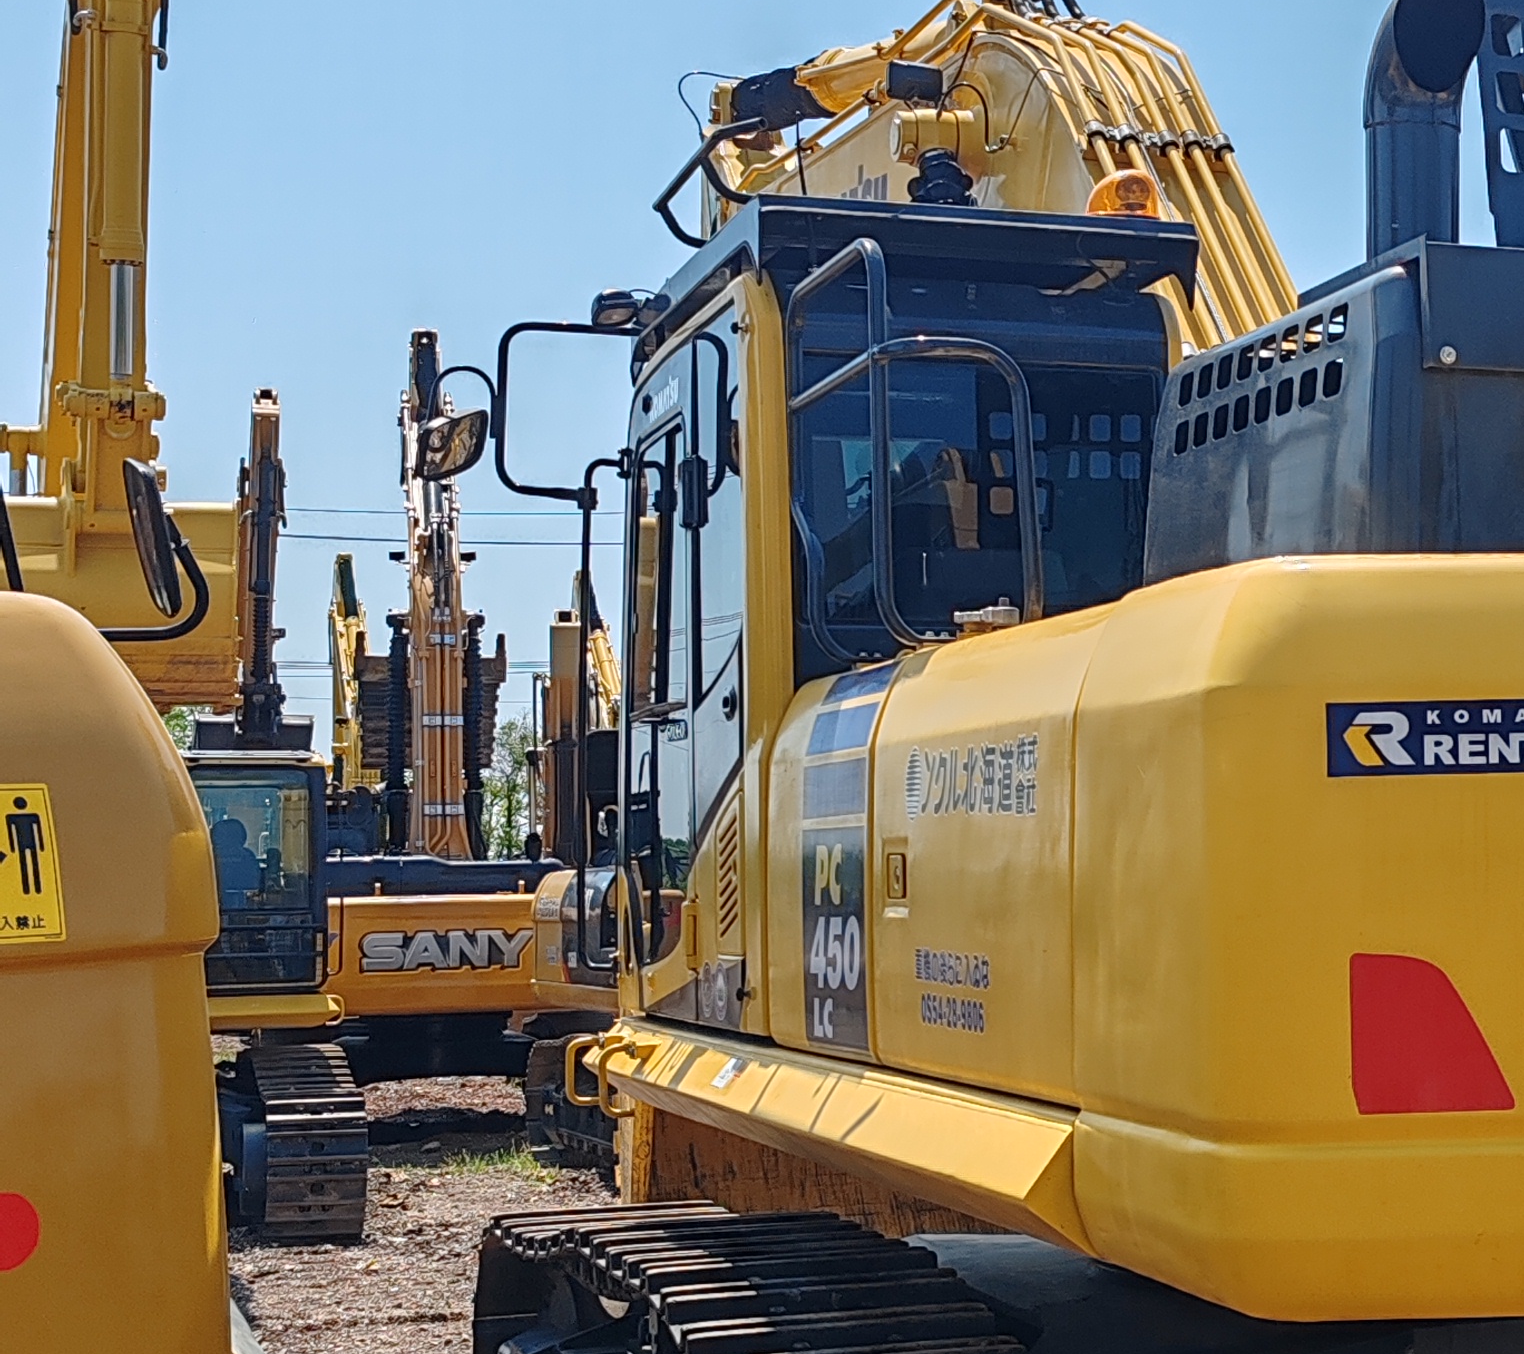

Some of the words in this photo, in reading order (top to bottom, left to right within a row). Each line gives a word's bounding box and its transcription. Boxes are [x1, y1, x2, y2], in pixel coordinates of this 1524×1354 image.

[815, 843, 842, 906] PC
[362, 929, 534, 972] SANY
[809, 915, 860, 991] 450
[814, 997, 834, 1038] LC
